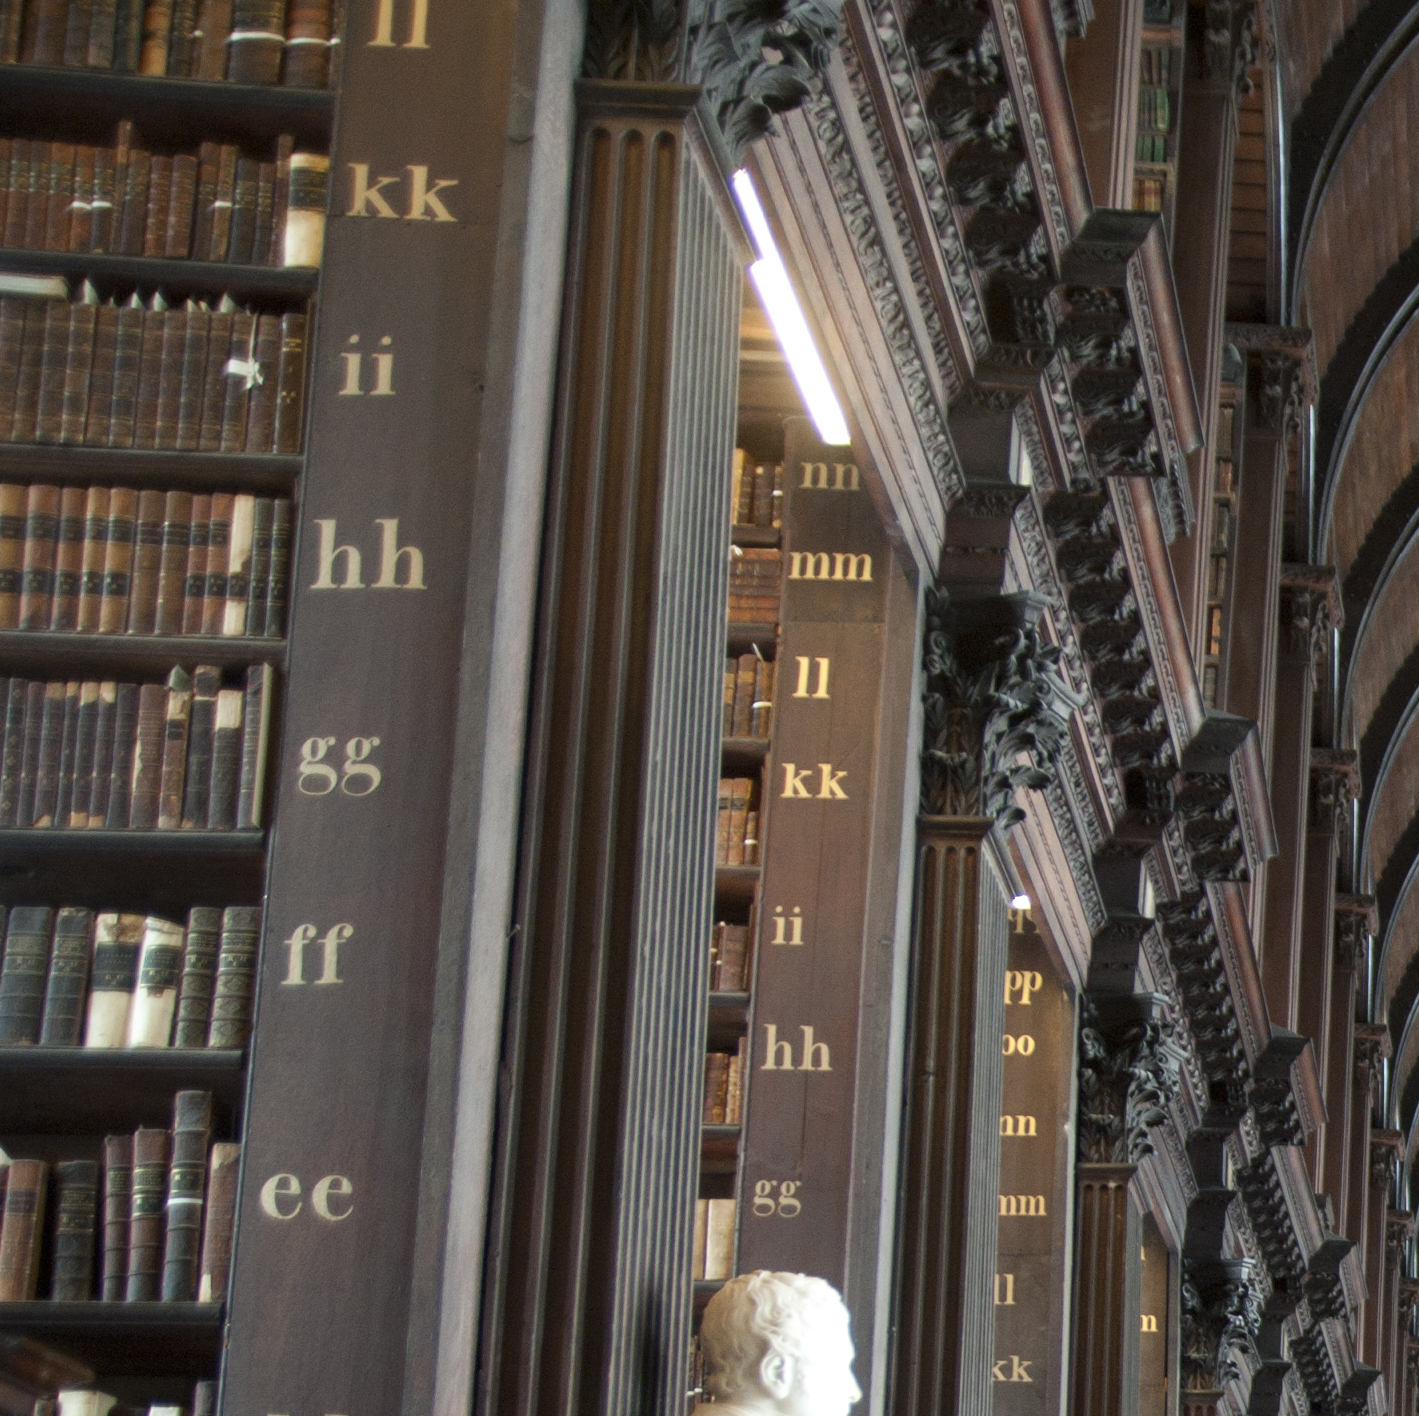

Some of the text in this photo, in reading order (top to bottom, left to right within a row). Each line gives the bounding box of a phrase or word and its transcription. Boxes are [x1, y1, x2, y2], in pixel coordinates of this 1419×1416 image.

[347, 163, 458, 222] kk
[339, 335, 395, 395] ii
[802, 461, 860, 491] nn
[310, 519, 426, 589] hh
[788, 552, 872, 581] mm
[793, 657, 829, 698] ll
[298, 737, 381, 796] gg
[781, 763, 848, 799] kk
[772, 906, 803, 945] ii
[281, 923, 353, 986] ff
[1004, 971, 1042, 1005] pp
[761, 1024, 832, 1071] hh
[259, 1173, 352, 1221] ee
[753, 1180, 801, 1217] gg
